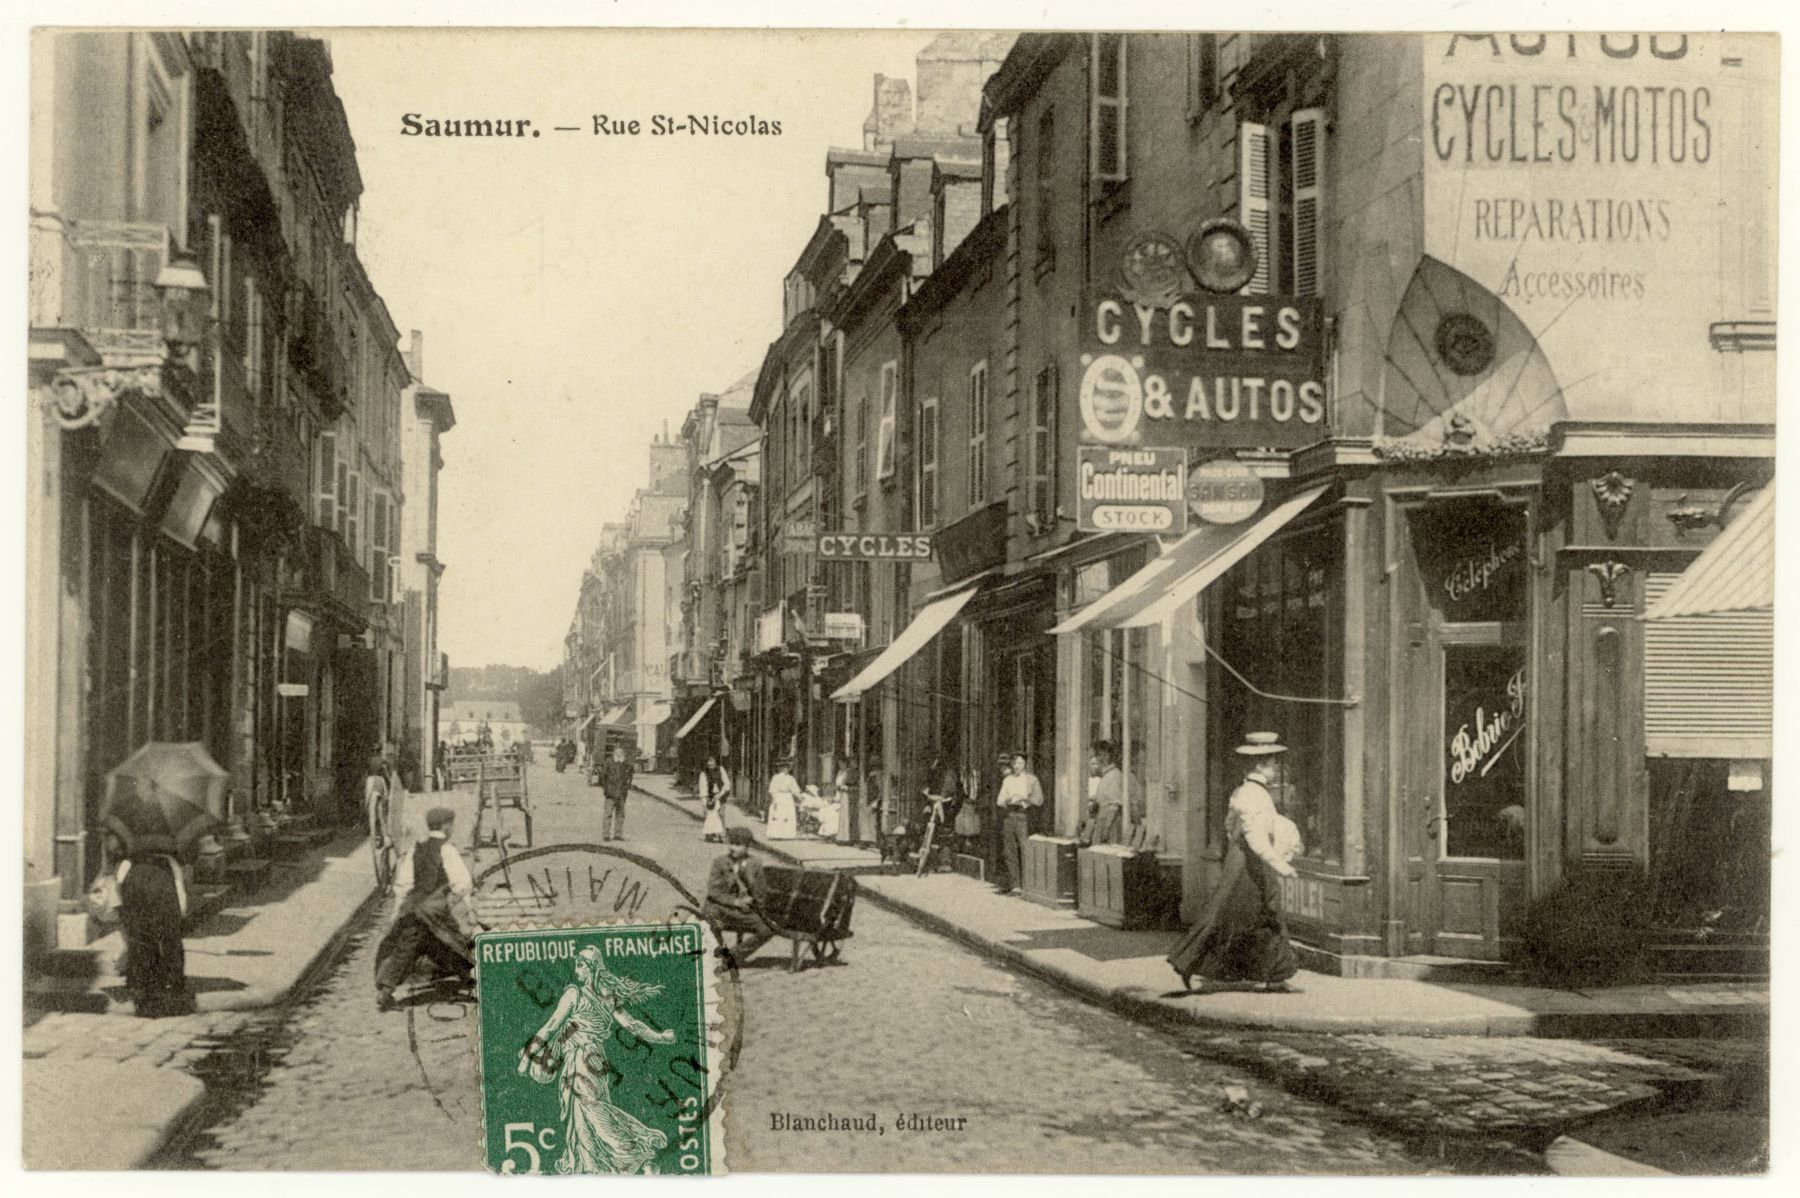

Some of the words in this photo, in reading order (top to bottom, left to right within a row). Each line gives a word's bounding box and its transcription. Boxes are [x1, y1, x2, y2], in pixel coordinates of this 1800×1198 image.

[1431, 82, 1577, 162] CYCLES
[1594, 85, 1711, 164] MOTOS
[1475, 198, 1671, 243] REPARATIONS
[1500, 257, 1647, 300] Accessoires
[1097, 300, 1300, 350] CYCLES
[1143, 374, 1176, 419] &
[1184, 375, 1324, 423] AUTOS
[1109, 451, 1156, 466] PNEU
[1081, 462, 1184, 501] Continental
[1103, 511, 1164, 525] STOCK
[819, 535, 931, 557] CYCLES
[494, 866, 649, 919] MAIN
[679, 1096, 699, 1175] OSTES
